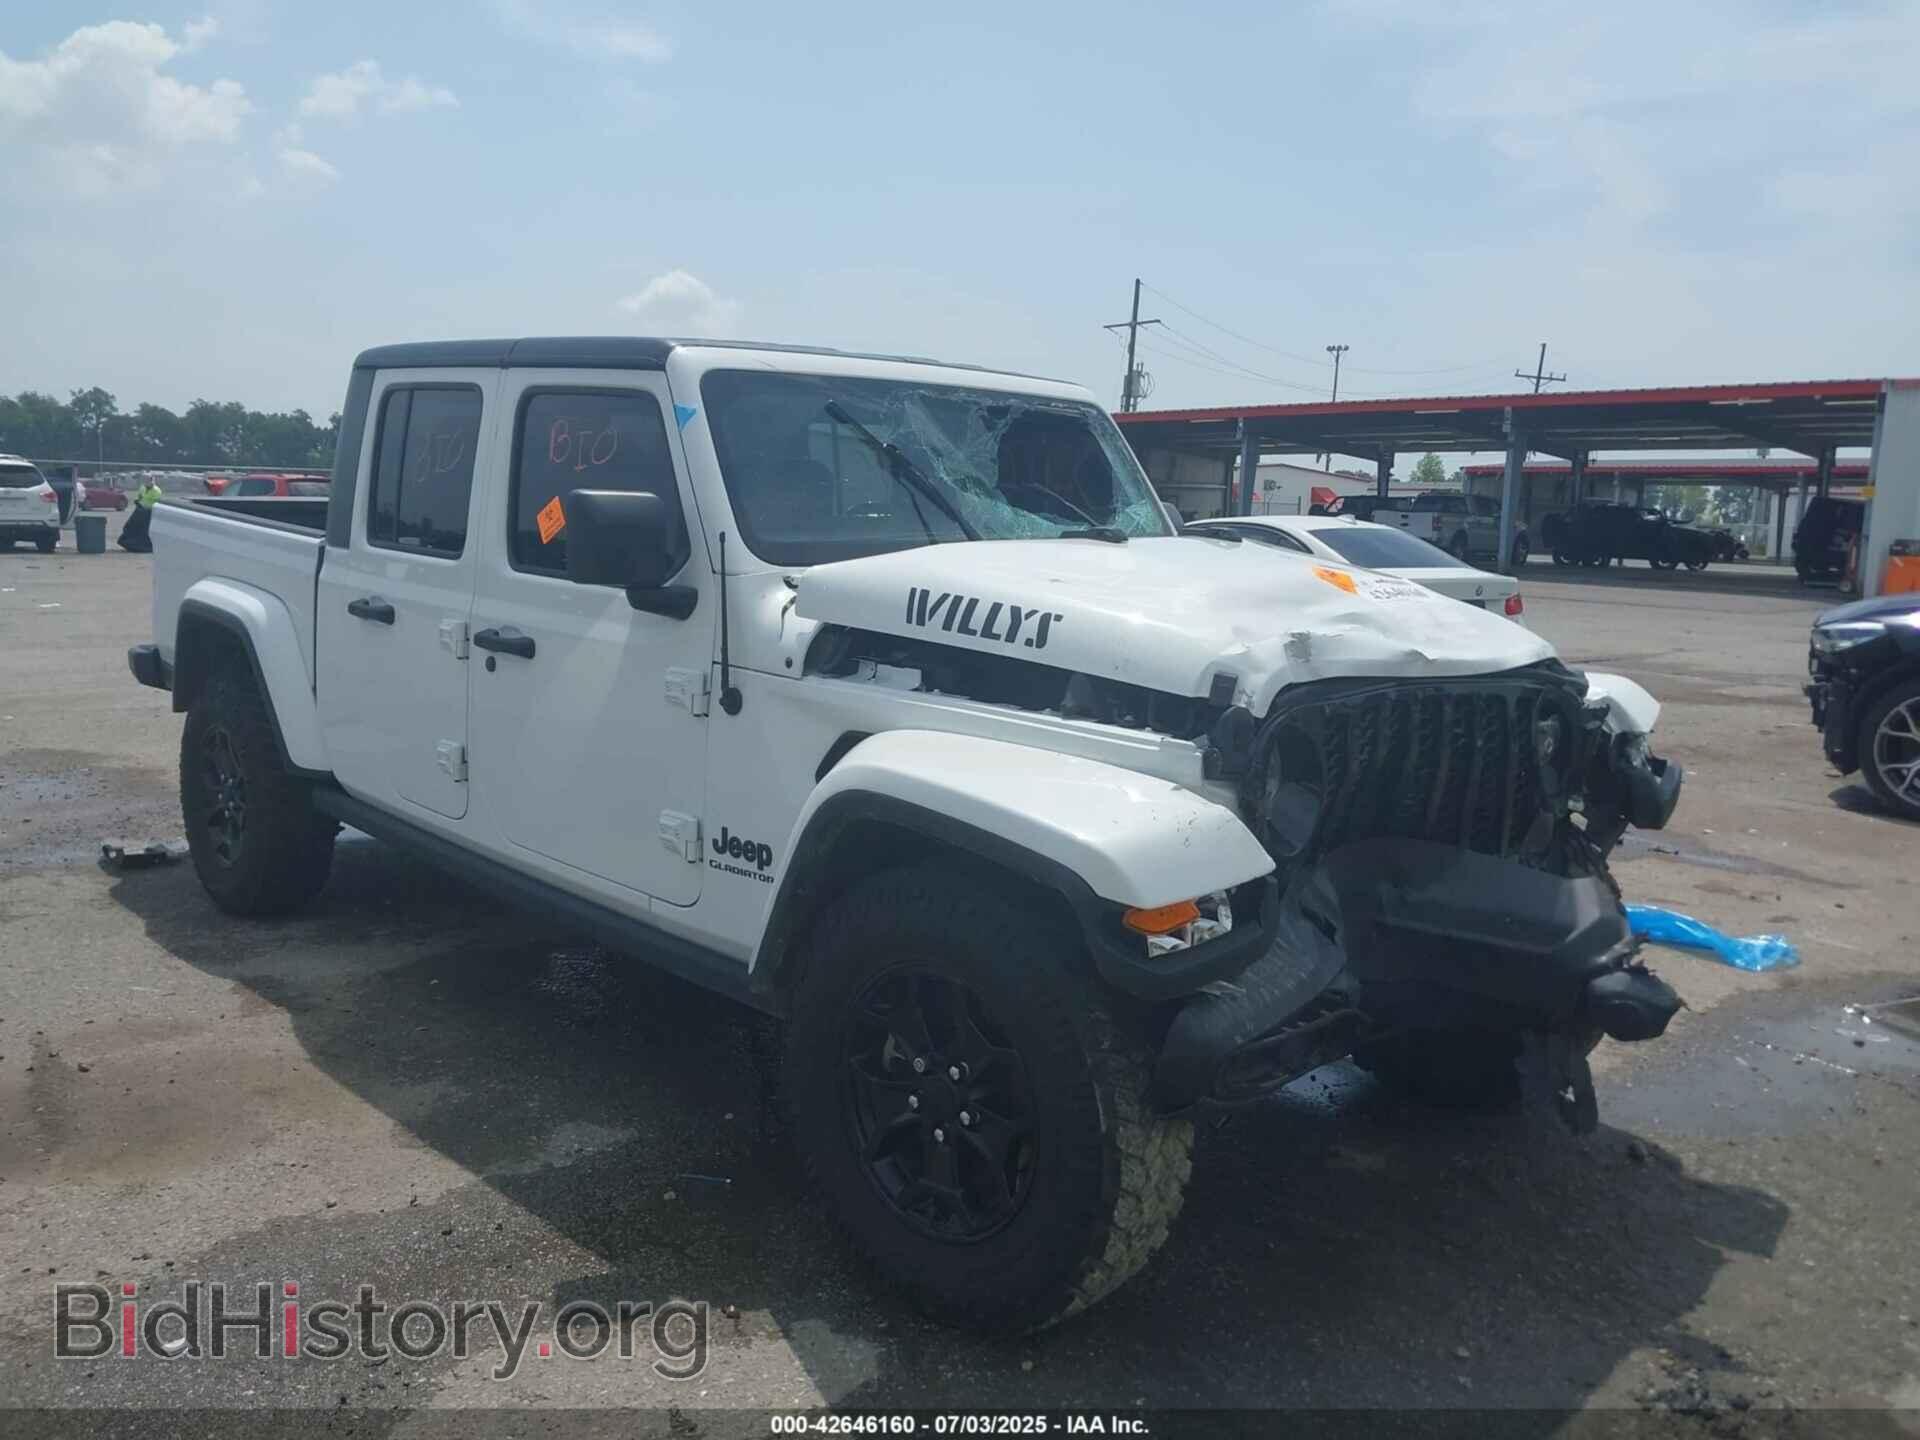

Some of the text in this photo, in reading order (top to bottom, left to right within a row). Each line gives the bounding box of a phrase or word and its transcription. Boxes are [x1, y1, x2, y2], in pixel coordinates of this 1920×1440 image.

[549, 418, 618, 471] BIO
[906, 587, 1063, 649] WILLYS
[709, 859, 775, 884] GLADIATOR
[712, 826, 773, 871] Jeep
